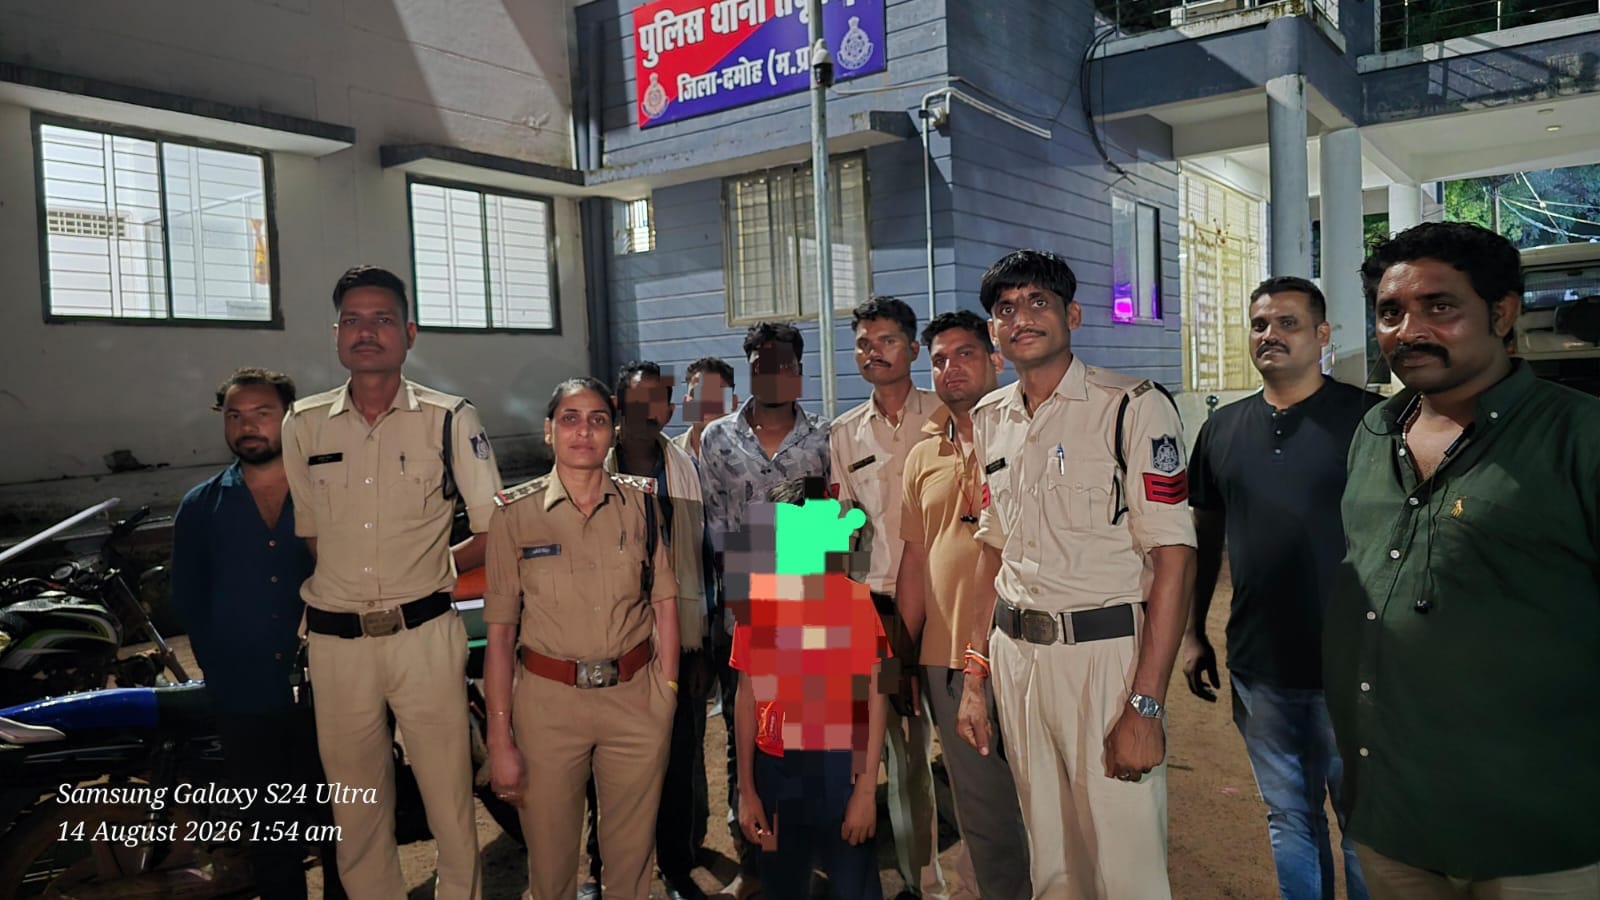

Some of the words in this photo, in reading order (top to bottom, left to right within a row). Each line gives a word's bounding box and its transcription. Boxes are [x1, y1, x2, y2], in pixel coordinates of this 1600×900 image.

[638, 8, 705, 68] पुलिस
[710, 0, 766, 34] थाना
[677, 57, 764, 103] जिला-दमोह
